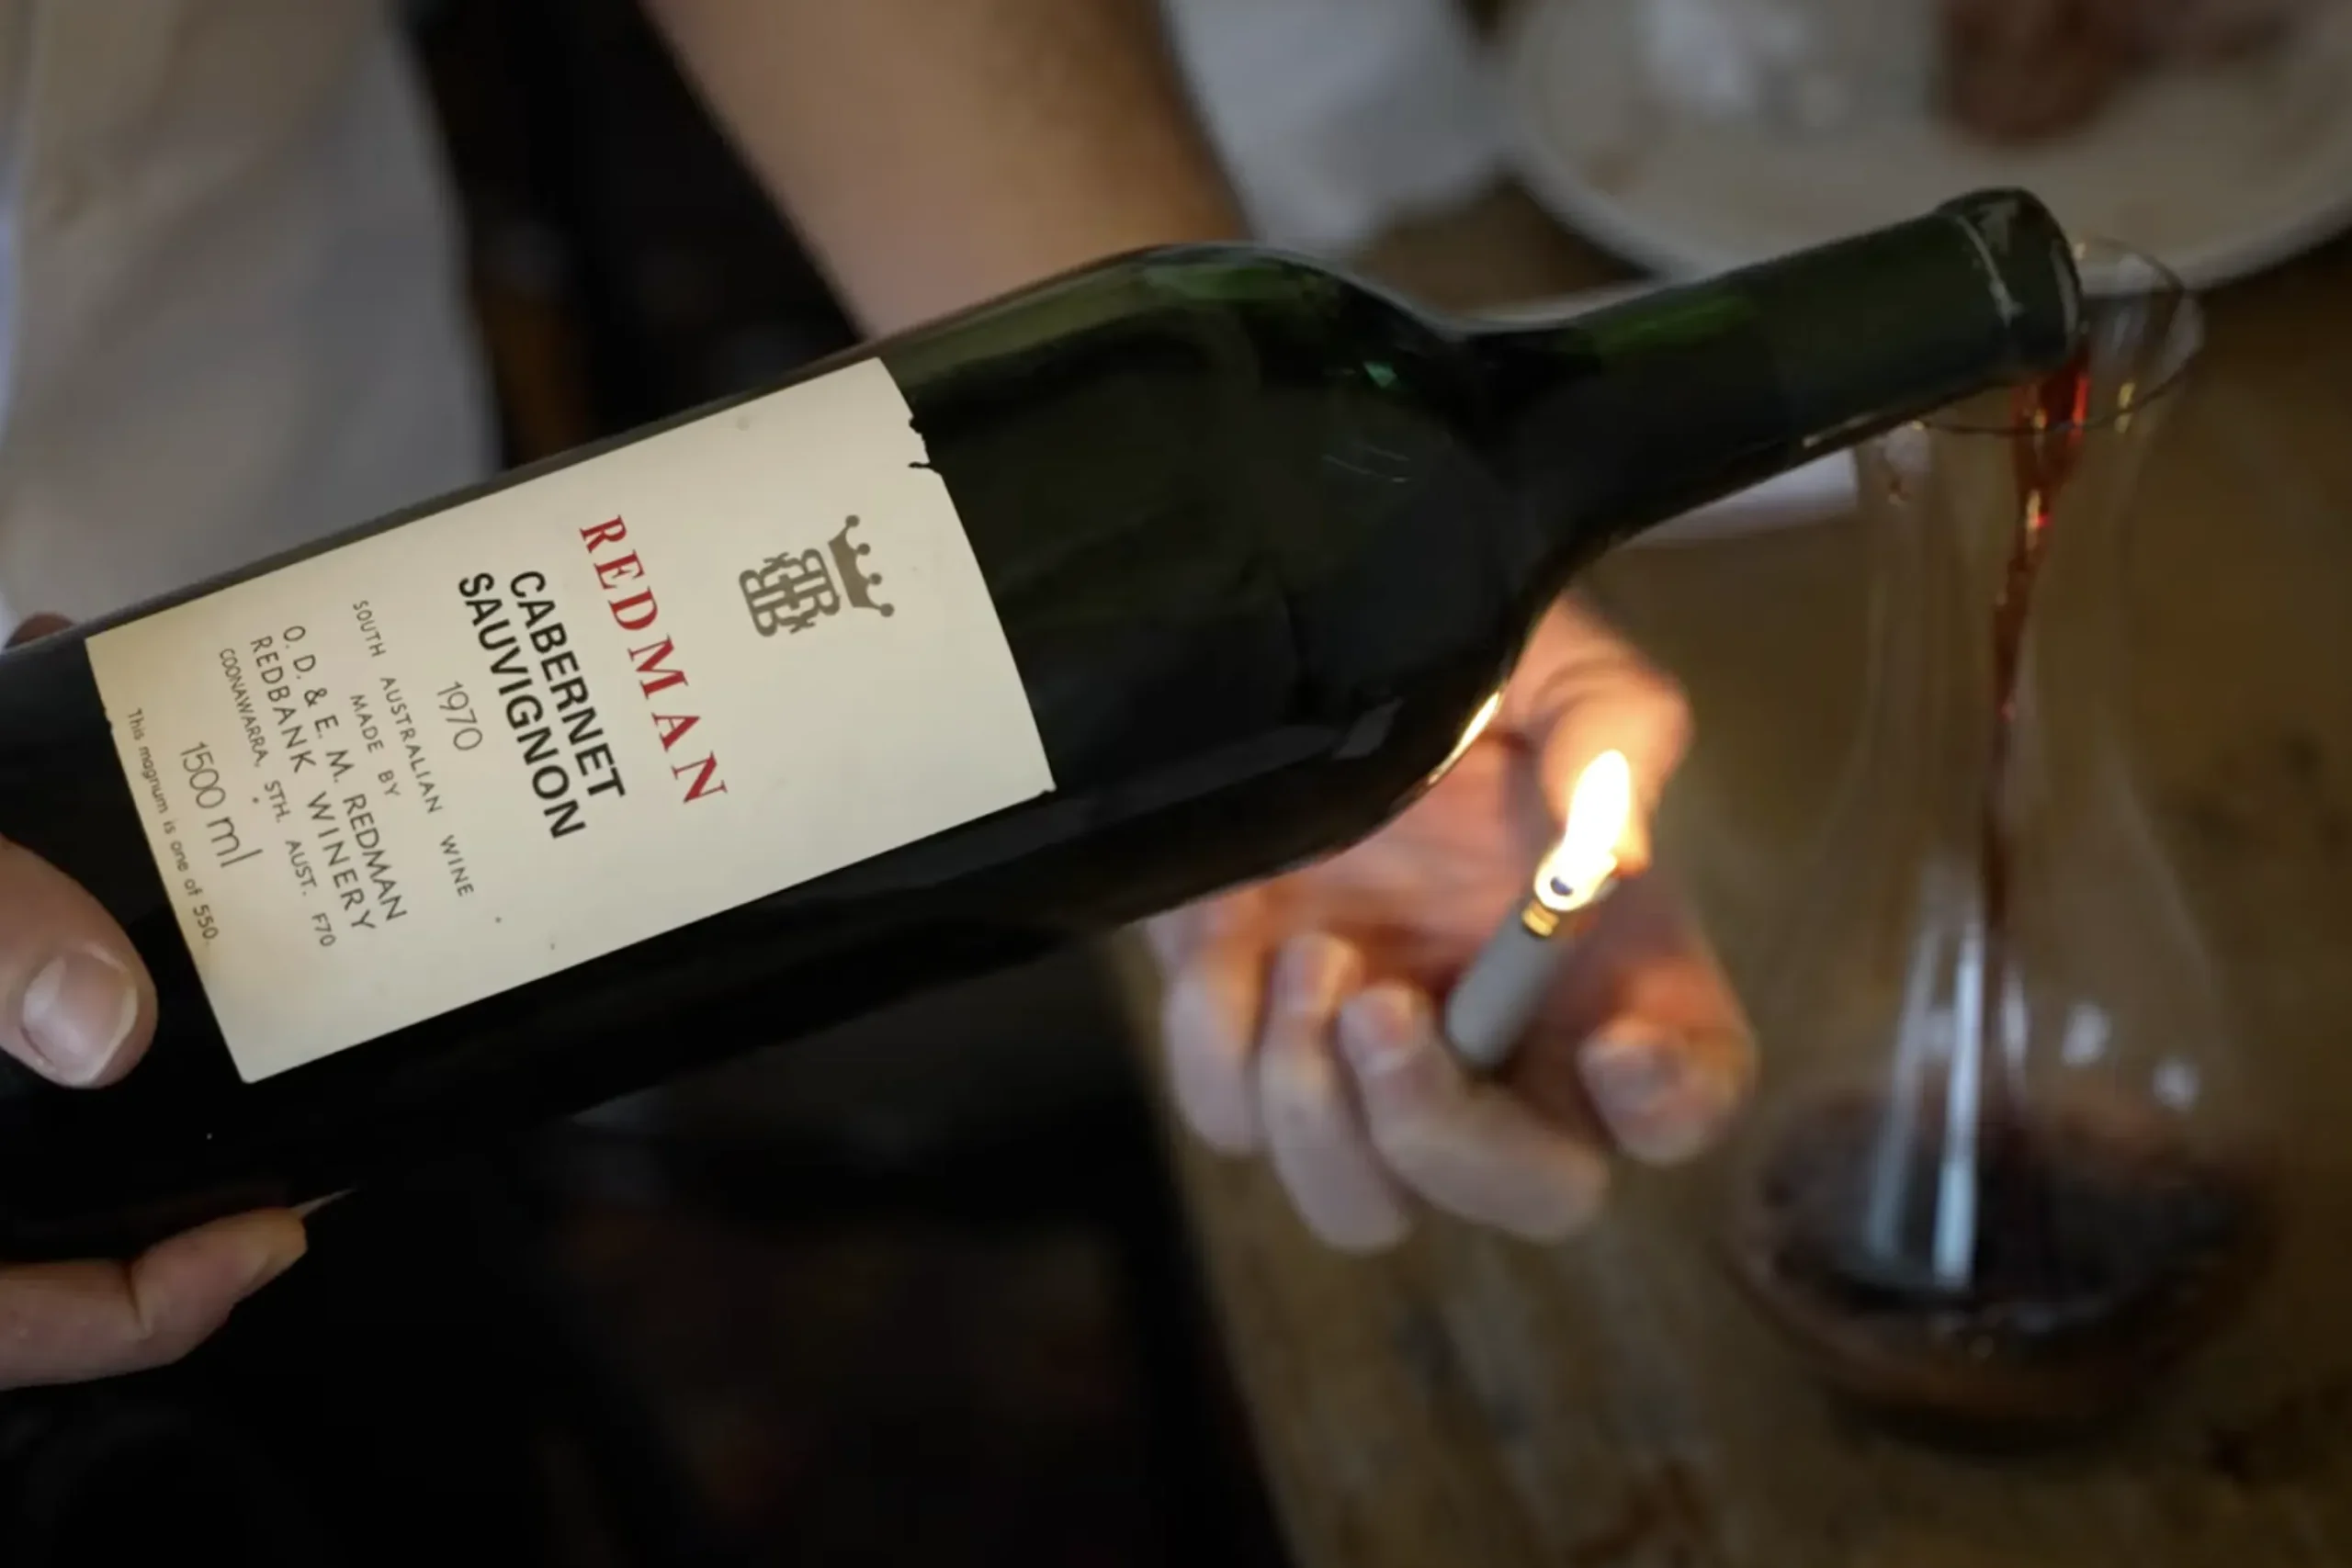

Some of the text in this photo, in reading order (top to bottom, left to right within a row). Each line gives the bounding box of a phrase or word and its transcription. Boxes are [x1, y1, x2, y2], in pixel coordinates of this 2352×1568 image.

[127, 706, 146, 741] This
[435, 680, 484, 752] 1970
[456, 570, 589, 841] SAUVIGNON
[507, 569, 628, 799] CABERNET
[577, 513, 729, 806] REDMAN
[138, 745, 170, 816] magnum
[179, 740, 265, 870] 1500 ml
[249, 634, 378, 931] REDBANK WINERY
[281, 624, 409, 923] O. D. & E. M. REDMAN
[348, 693, 402, 797] MADE BY
[351, 599, 476, 898] SOUTH AUSTRALIAN WINE
[162, 819, 177, 836] is
[169, 840, 190, 873] one
[183, 877, 204, 897] of
[263, 778, 292, 825] STH.
[283, 839, 319, 898] AUST.
[311, 911, 338, 948] F70
